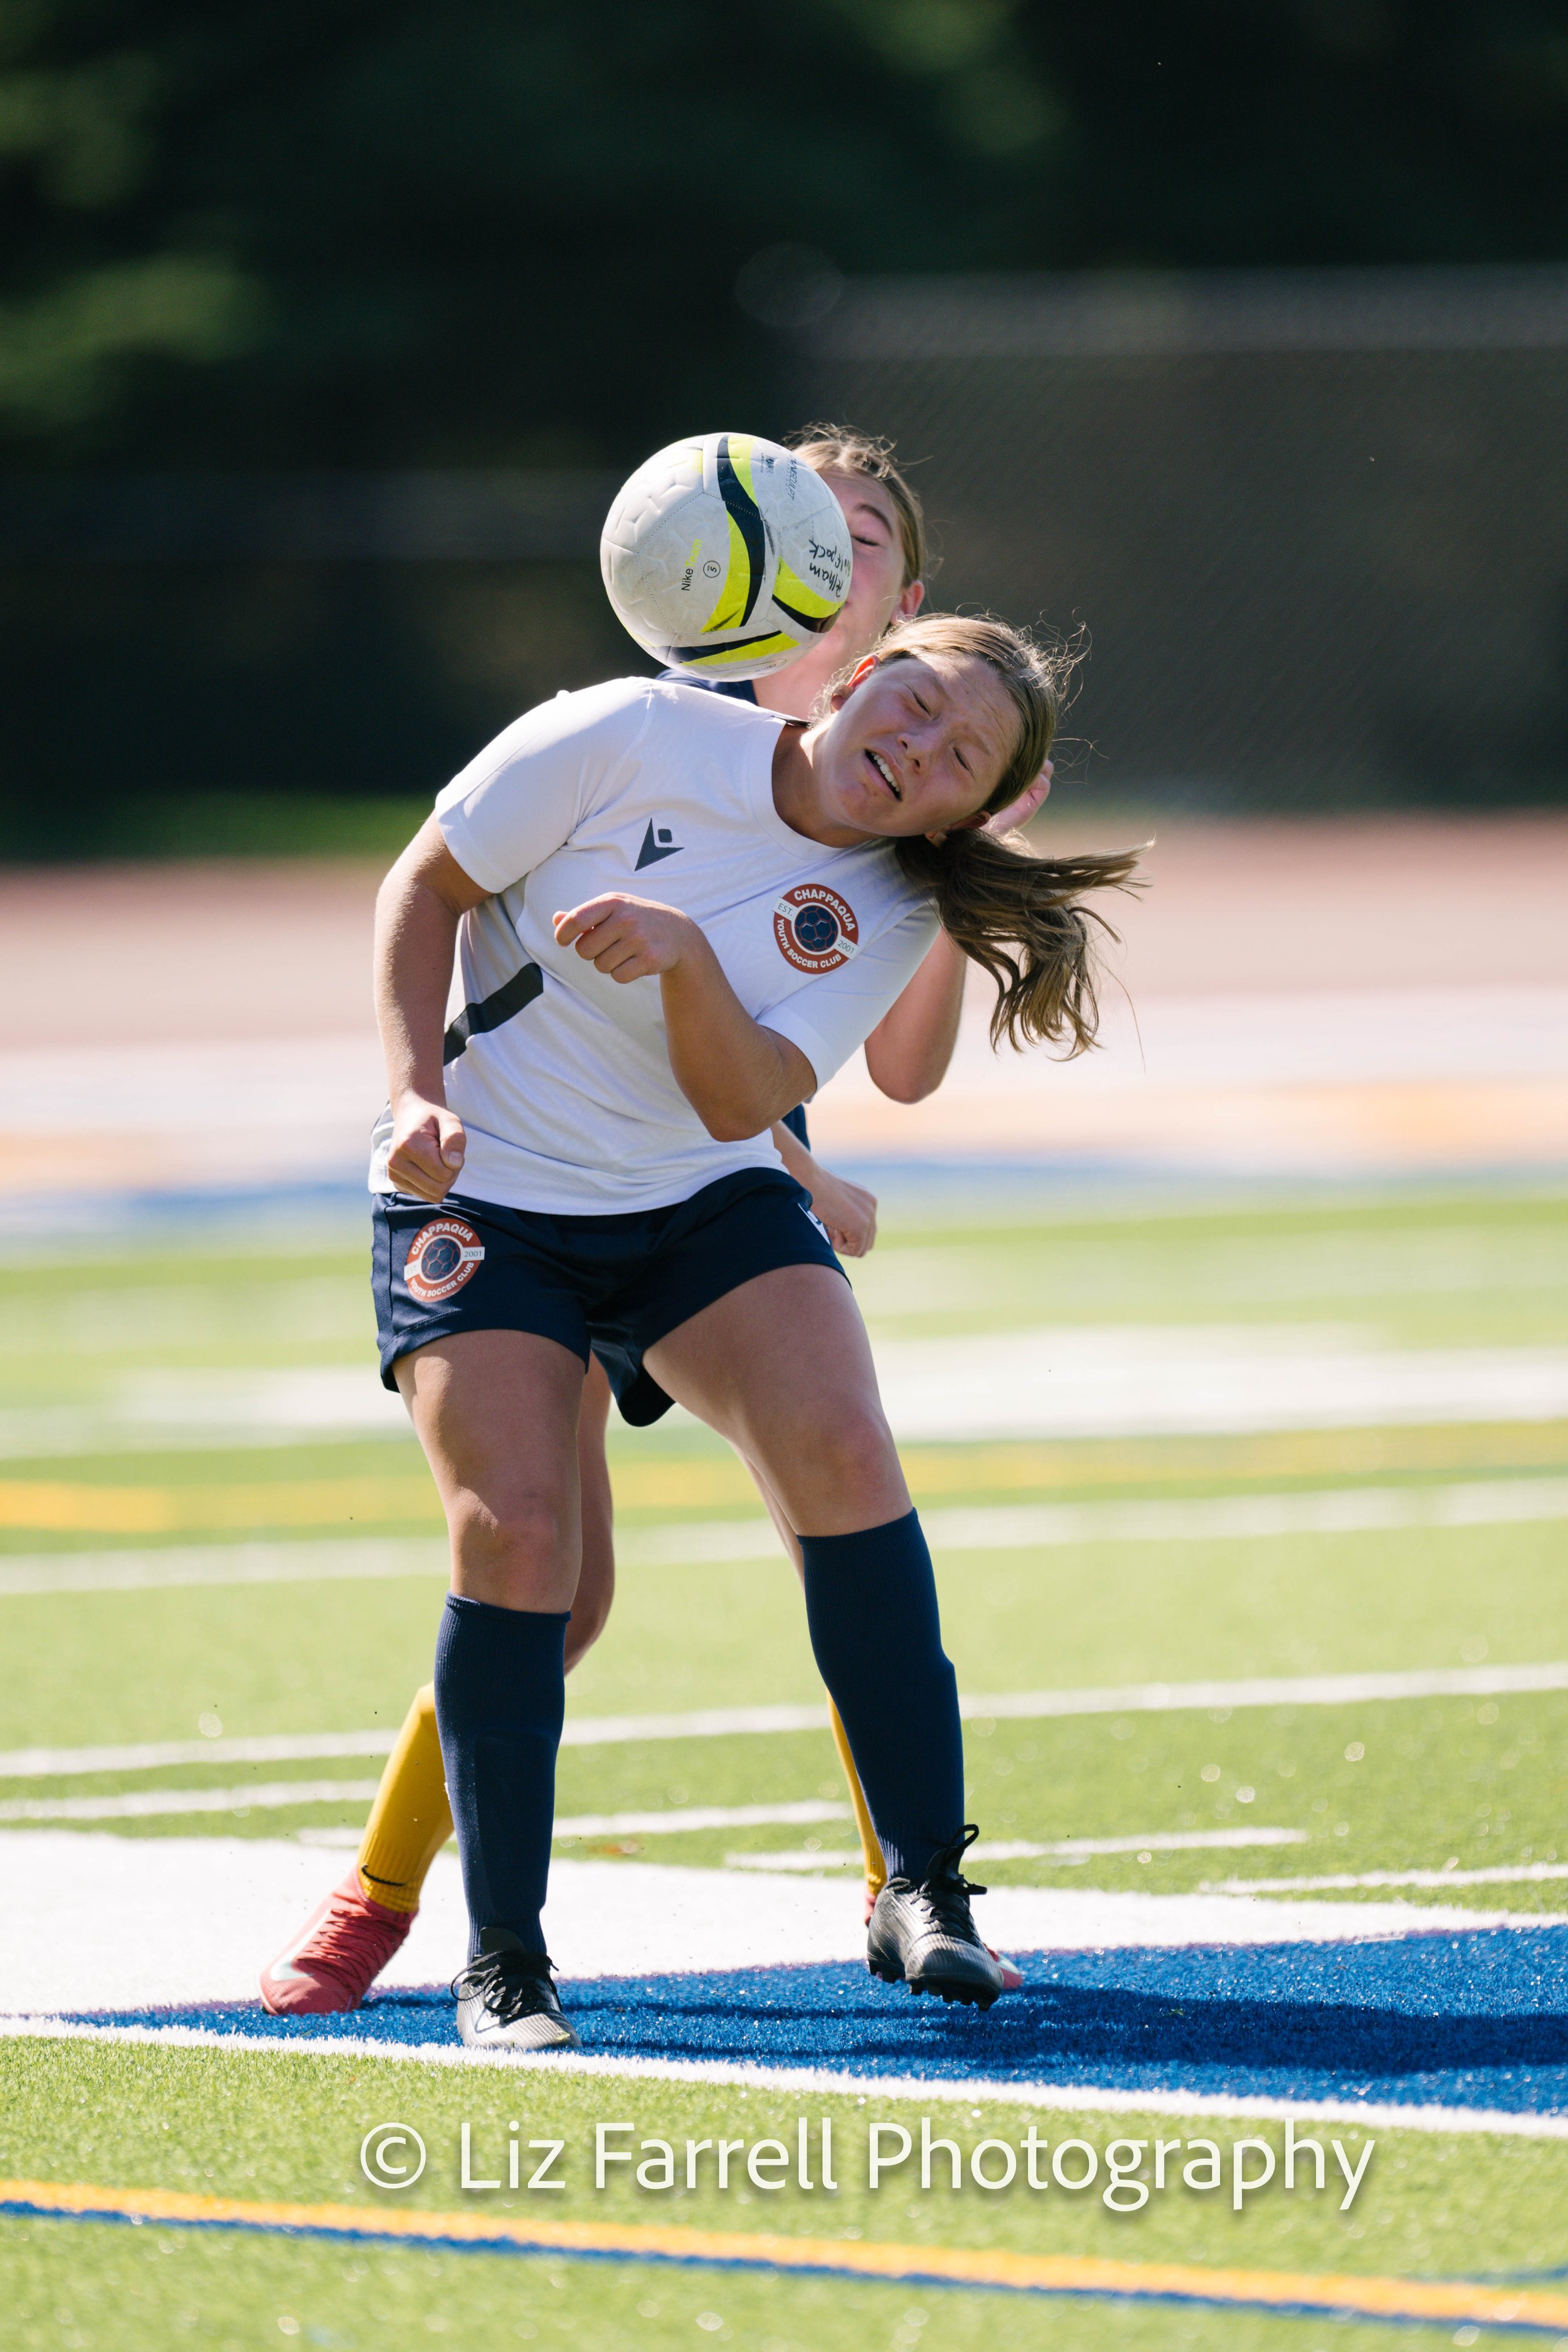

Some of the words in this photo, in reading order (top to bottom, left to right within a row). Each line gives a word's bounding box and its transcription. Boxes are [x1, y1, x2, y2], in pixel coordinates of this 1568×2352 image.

[681, 568, 694, 591] Nike
[778, 903, 793, 916] EST.
[794, 889, 855, 931] CHAPPAQUA
[777, 919, 790, 949] YOUTH
[787, 948, 818, 968] SOCCER
[820, 954, 842, 968] CLUB
[837, 940, 854, 954] 2001
[411, 1222, 474, 1255] CHAPPAQUA
[410, 1278, 427, 1296] YOUTH
[426, 1280, 457, 1298] SOCCER
[457, 1262, 474, 1282] CLUB
